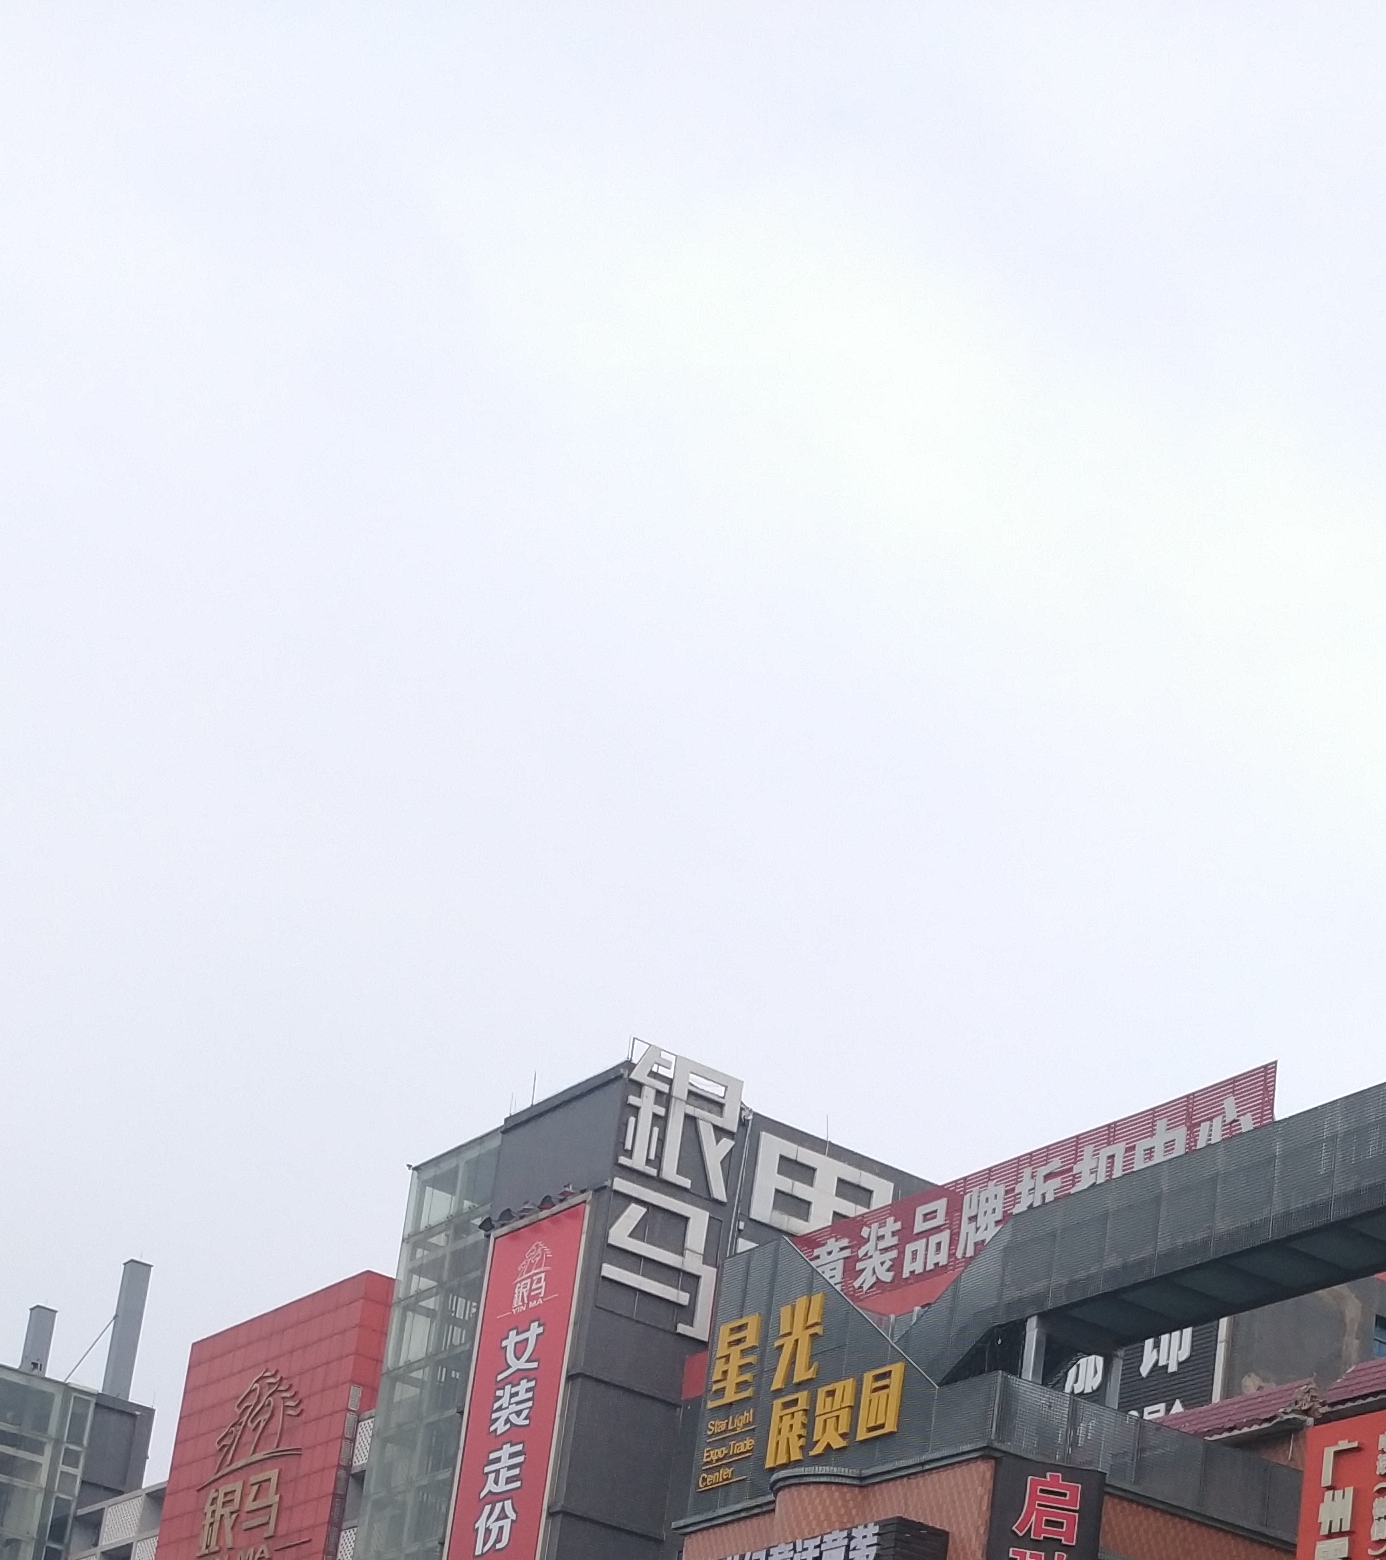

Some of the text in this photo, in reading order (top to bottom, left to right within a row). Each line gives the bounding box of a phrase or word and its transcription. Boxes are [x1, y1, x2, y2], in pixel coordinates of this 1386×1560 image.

[706, 1291, 825, 1410] 星光
[764, 1361, 906, 1470] 展贸园
[698, 1466, 734, 1488] Center
